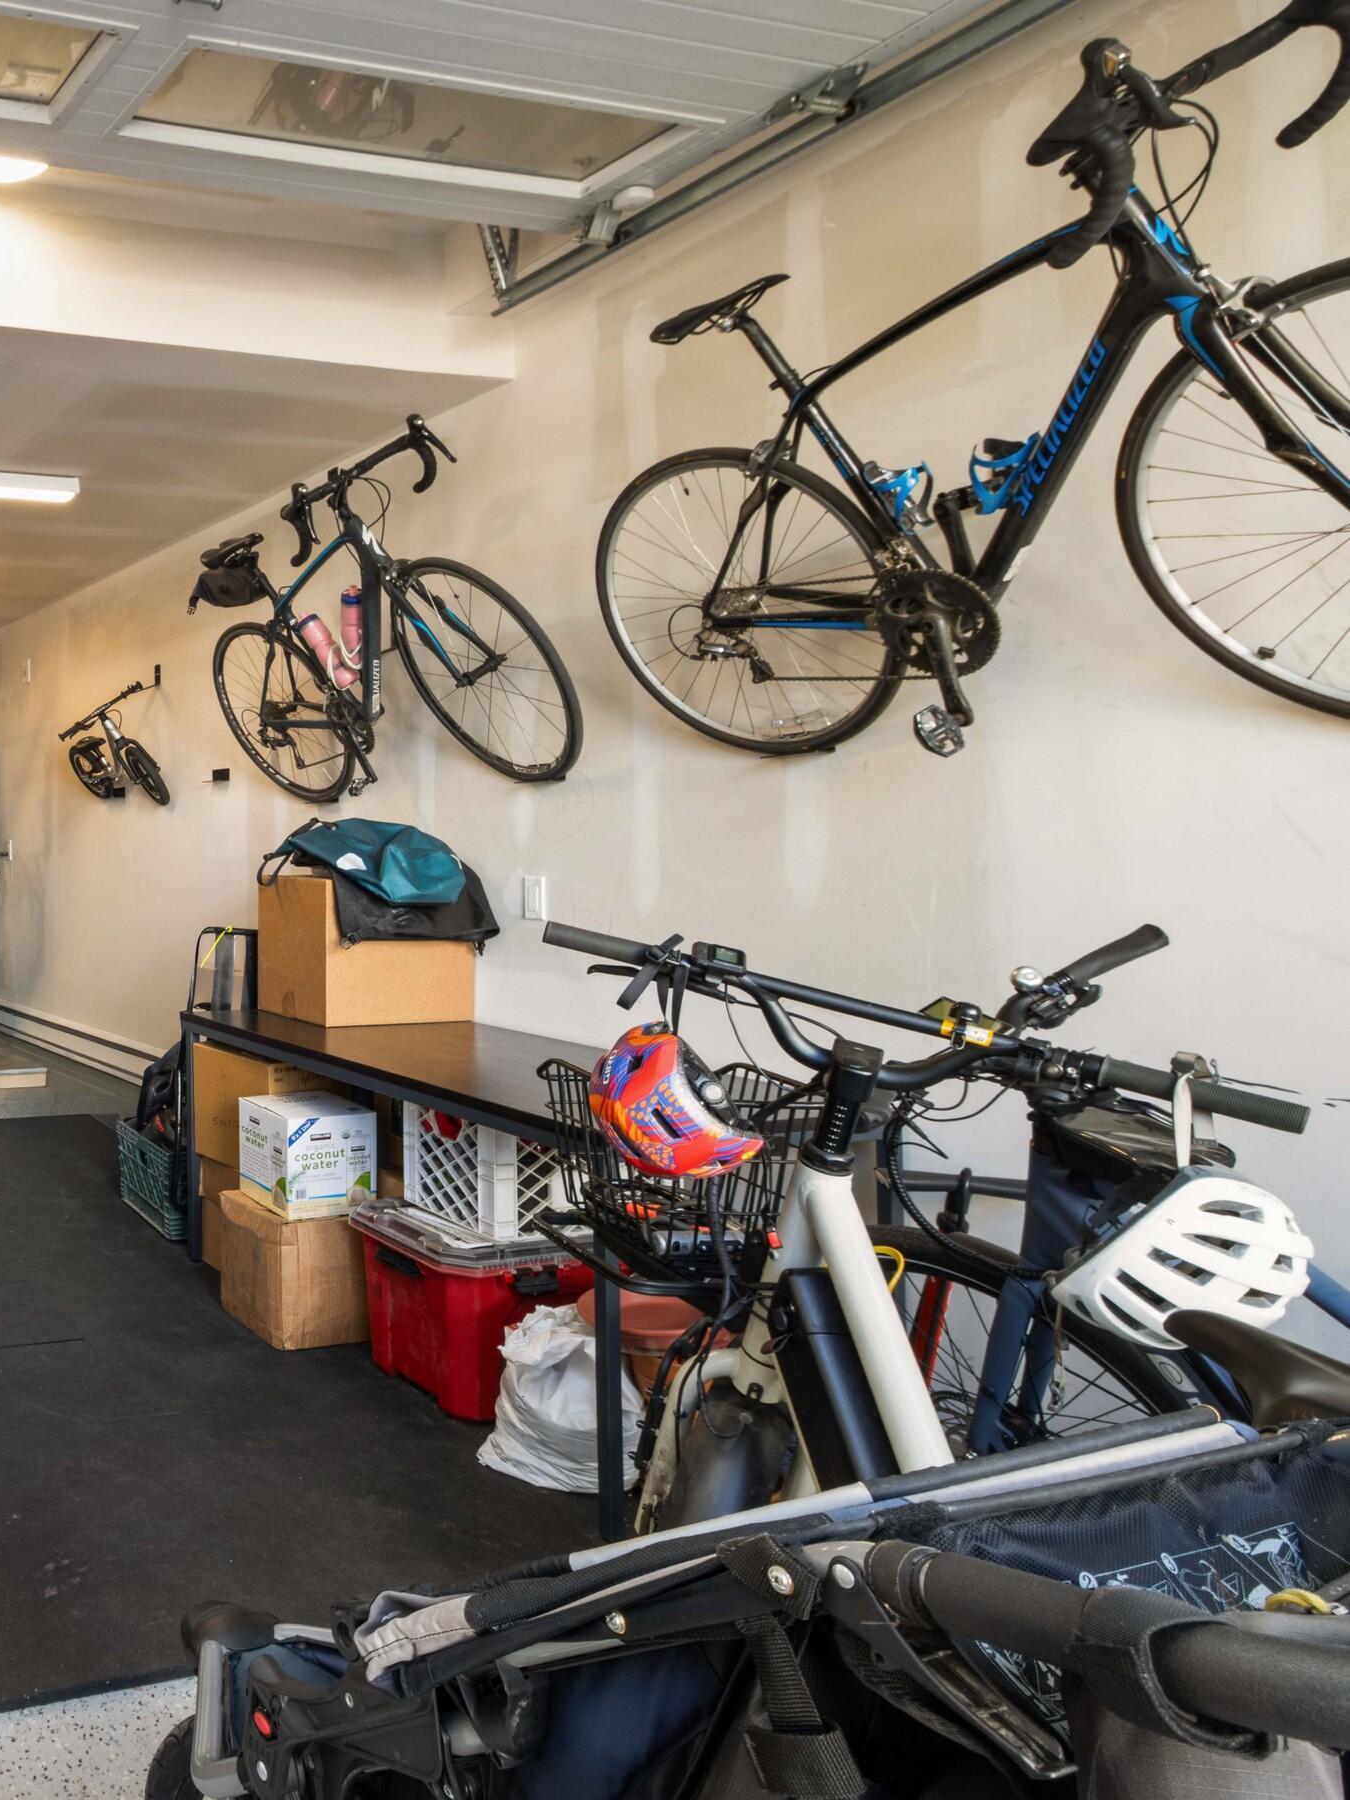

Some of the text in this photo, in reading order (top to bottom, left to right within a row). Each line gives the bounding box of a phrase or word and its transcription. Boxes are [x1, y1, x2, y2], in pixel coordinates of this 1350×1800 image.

[602, 1049, 618, 1085] GIRO
[241, 1125, 268, 1144] coconut
[294, 1148, 346, 1162] coconut
[301, 1159, 339, 1171] water
